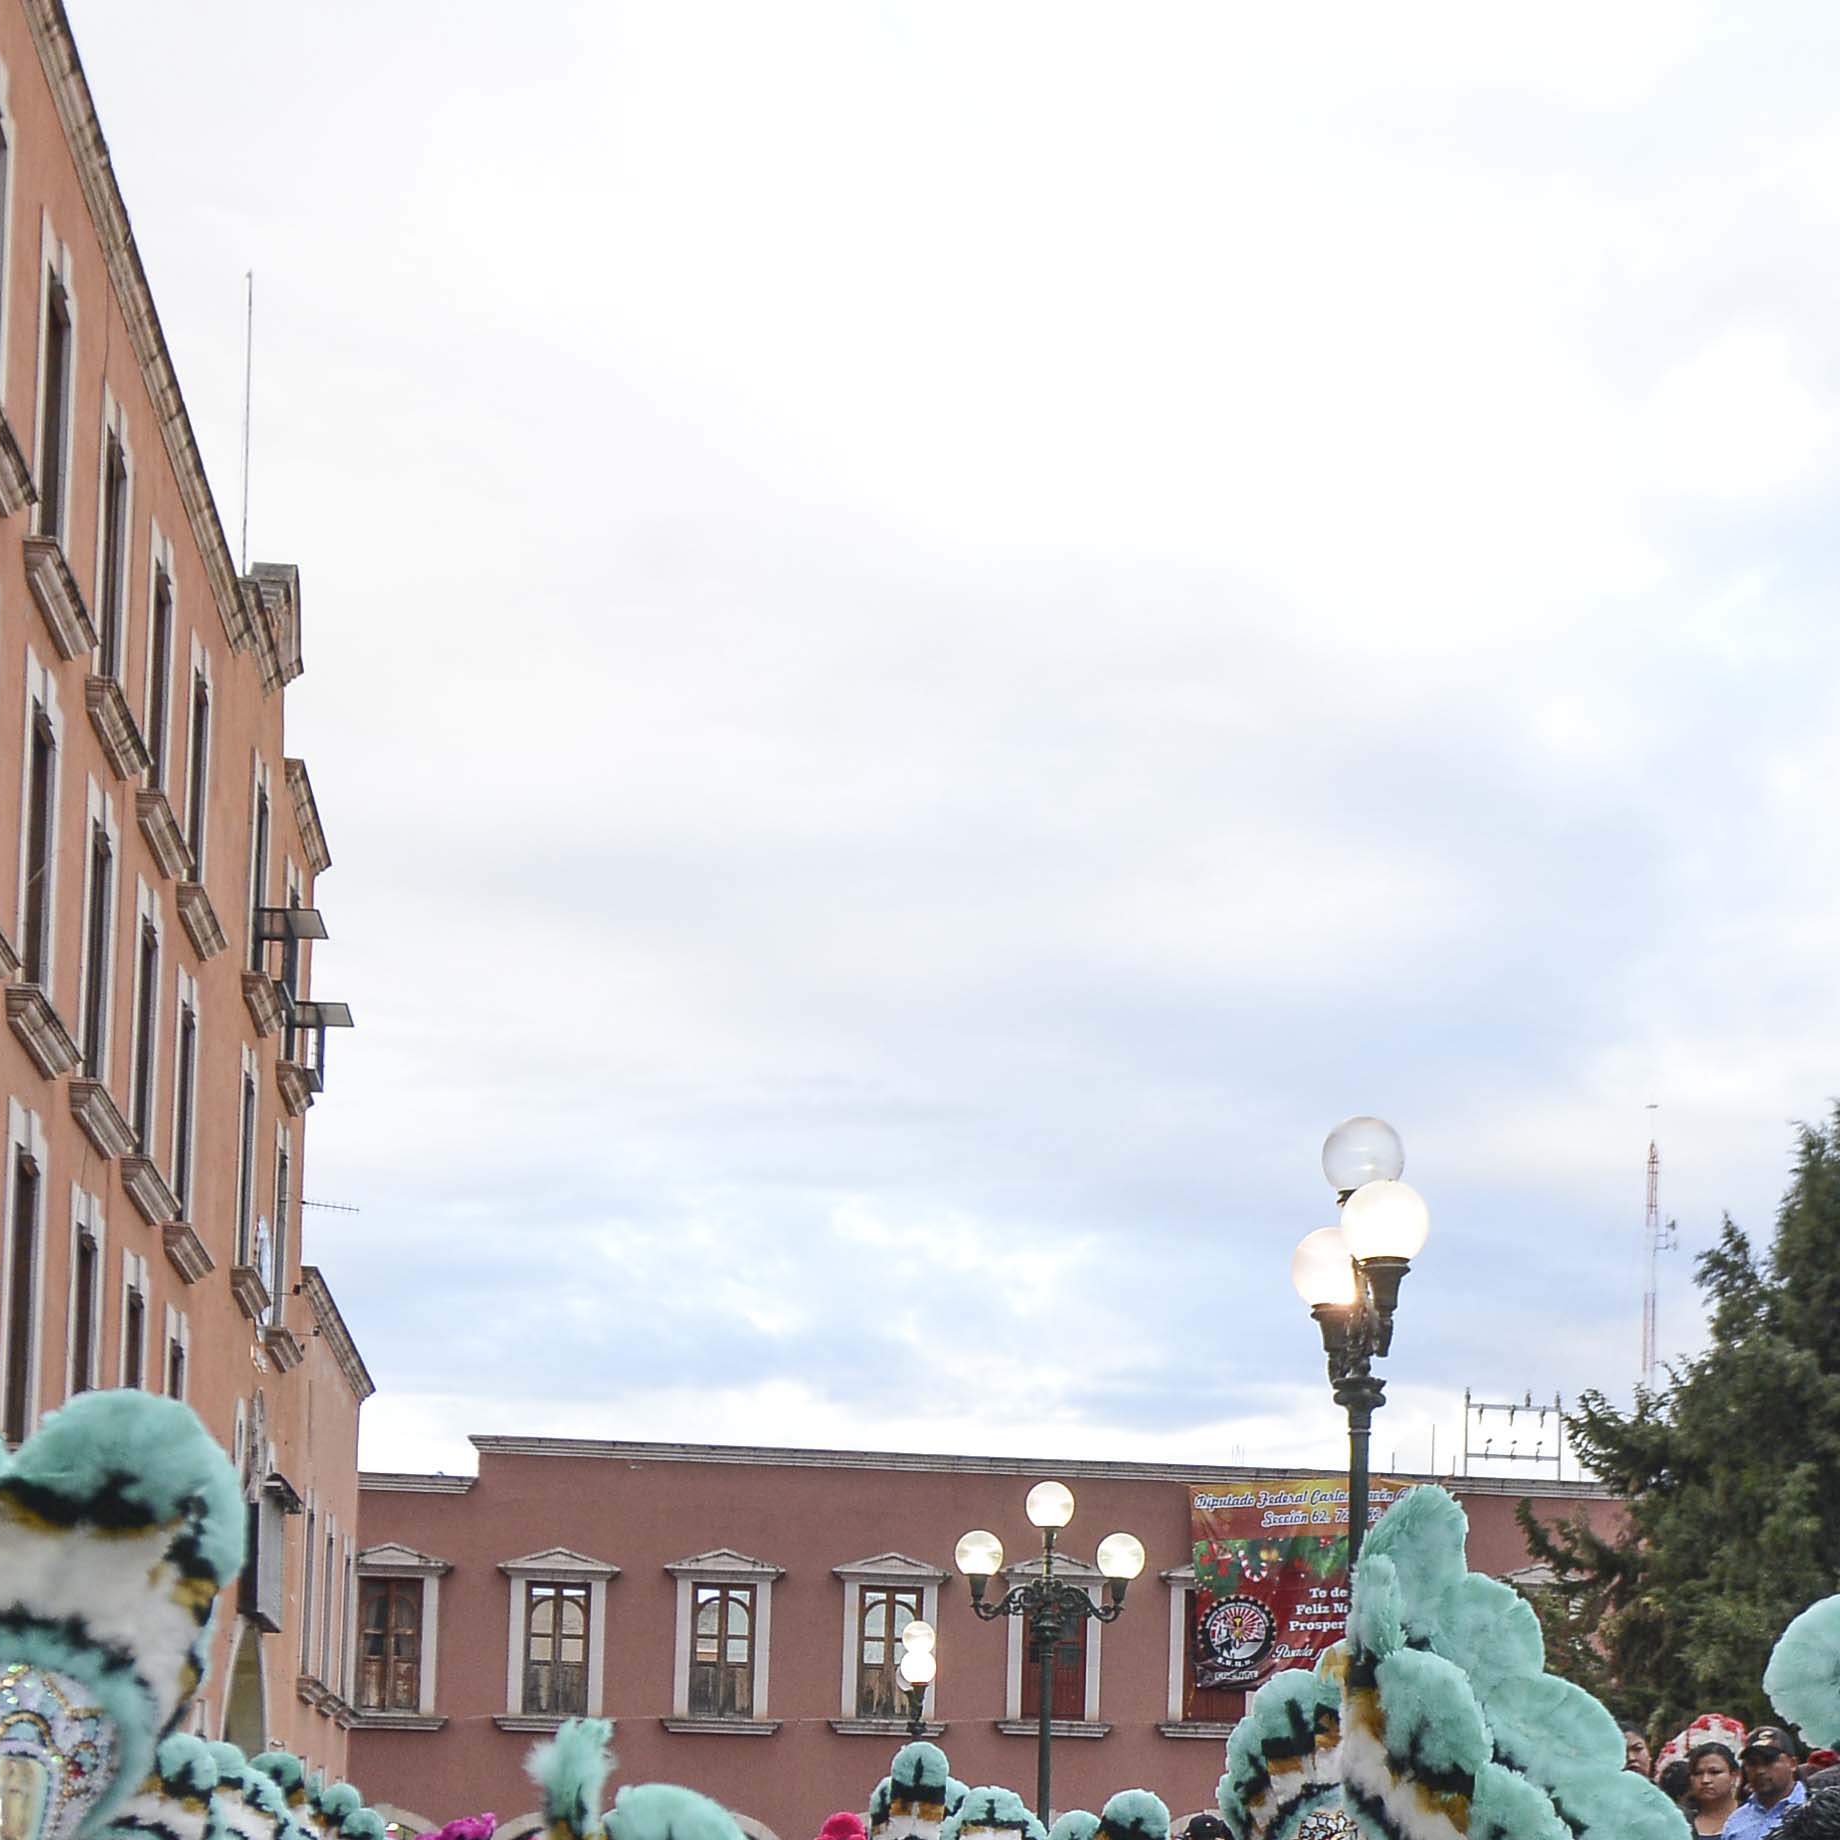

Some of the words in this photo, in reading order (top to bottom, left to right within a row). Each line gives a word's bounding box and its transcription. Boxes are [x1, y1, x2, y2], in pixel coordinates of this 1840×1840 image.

[1195, 1491, 1256, 1511] Diputado
[1257, 1490, 1309, 1508] Federal
[1261, 1510, 1308, 1527] Sección
[1309, 1587, 1327, 1598] Te
[1295, 1602, 1329, 1615] Feliz
